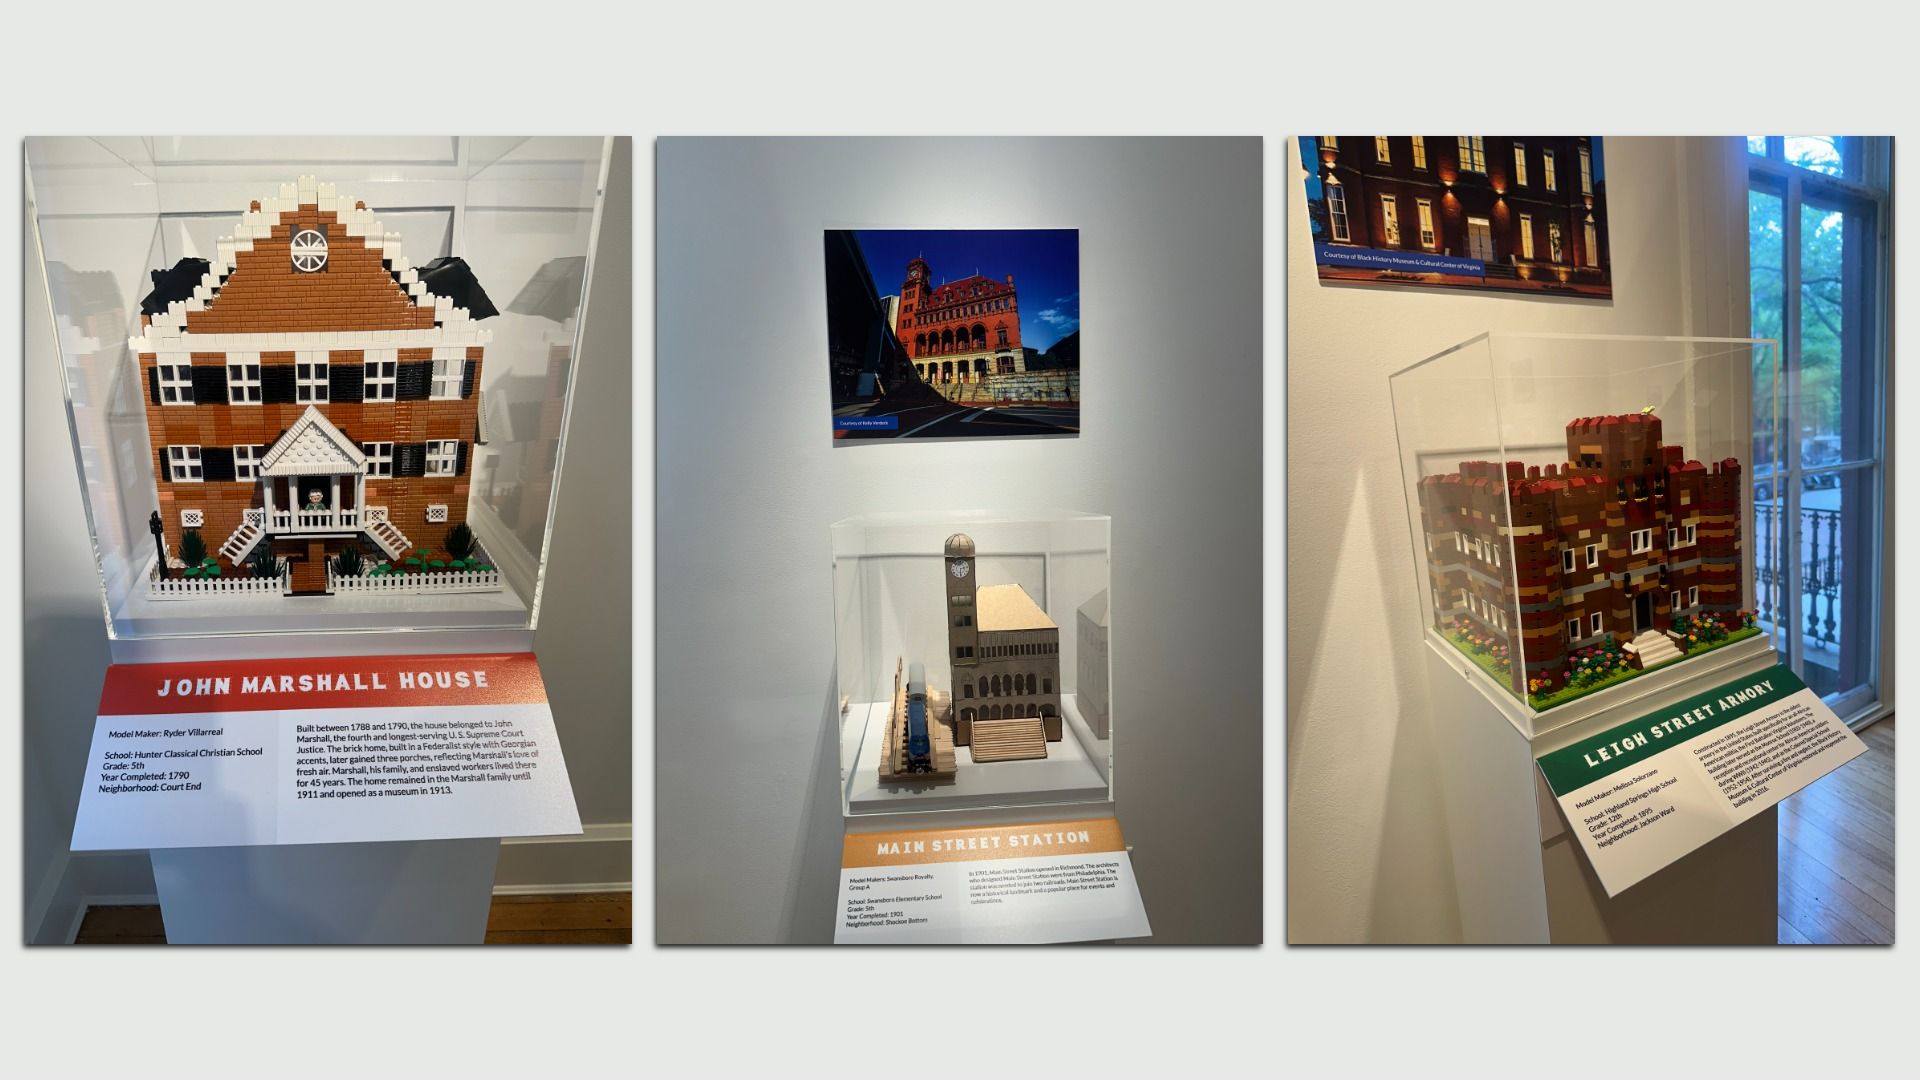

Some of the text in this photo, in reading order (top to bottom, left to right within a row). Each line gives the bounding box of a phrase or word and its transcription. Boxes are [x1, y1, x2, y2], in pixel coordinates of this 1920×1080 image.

[1324, 251, 1349, 259] Courtesy
[158, 671, 489, 696] JOHN MARSHALL HOUSE
[297, 725, 315, 733] Built
[351, 723, 371, 731] 1788
[388, 722, 410, 731] 1790,
[448, 721, 483, 729] belonged
[1584, 680, 1773, 767] LEIGH STREET ARMORY
[135, 730, 162, 738] Maker:
[164, 729, 186, 738] Ryder
[188, 728, 223, 736] Villarreal
[297, 734, 332, 743] Marshall,
[347, 733, 372, 741] fourth
[373, 733, 387, 741] and
[448, 731, 457, 739] U.
[458, 731, 465, 739] S.
[466, 731, 500, 740] Supreme
[134, 751, 163, 759] Hunter
[164, 749, 198, 758] Classical
[199, 749, 235, 757] Christian
[236, 747, 263, 756] School
[297, 746, 325, 754] Justice.
[327, 745, 342, 753] The
[343, 744, 363, 752] brick
[364, 744, 388, 752] home,
[389, 743, 407, 751] built
[423, 742, 461, 750] Federalist
[462, 741, 481, 750] style
[482, 740, 500, 749] with
[500, 740, 536, 748] Georgian
[296, 757, 329, 765] accents,
[330, 756, 348, 764] later
[349, 755, 375, 765] gained
[400, 754, 433, 763] porches,
[434, 752, 472, 761] reflecting
[531, 750, 539, 758] of
[103, 762, 145, 770] Grade: 5th
[297, 768, 317, 776] fresh
[332, 766, 369, 775] Marshall,
[370, 766, 382, 774] his
[382, 765, 409, 774] family,
[410, 764, 424, 773] and
[426, 763, 460, 772] enslaved
[461, 762, 494, 771] workers
[494, 761, 514, 770] lived
[515, 761, 536, 769] there
[101, 771, 190, 782] Year Completed: 1790
[296, 772, 531, 788] for 45 years. The home remained in the Marshall family until
[99, 782, 202, 794] Neighborhood: Court End
[298, 790, 318, 799] 1911
[320, 790, 334, 798] and
[336, 789, 366, 799] opened
[420, 787, 428, 795] in
[430, 786, 453, 794] 1913.
[1576, 797, 1595, 809] Model
[1594, 790, 1613, 801] Maker:
[1613, 780, 1634, 792] Melissa
[1584, 777, 1677, 825] School: Highland Springs High School
[1588, 813, 1622, 832] Grade: 12th
[1592, 807, 1653, 840] Year Completed: 1895
[1597, 806, 1675, 849] Neighborhood: Jackson Ward
[878, 832, 1088, 855] MAIN STREET STATION
